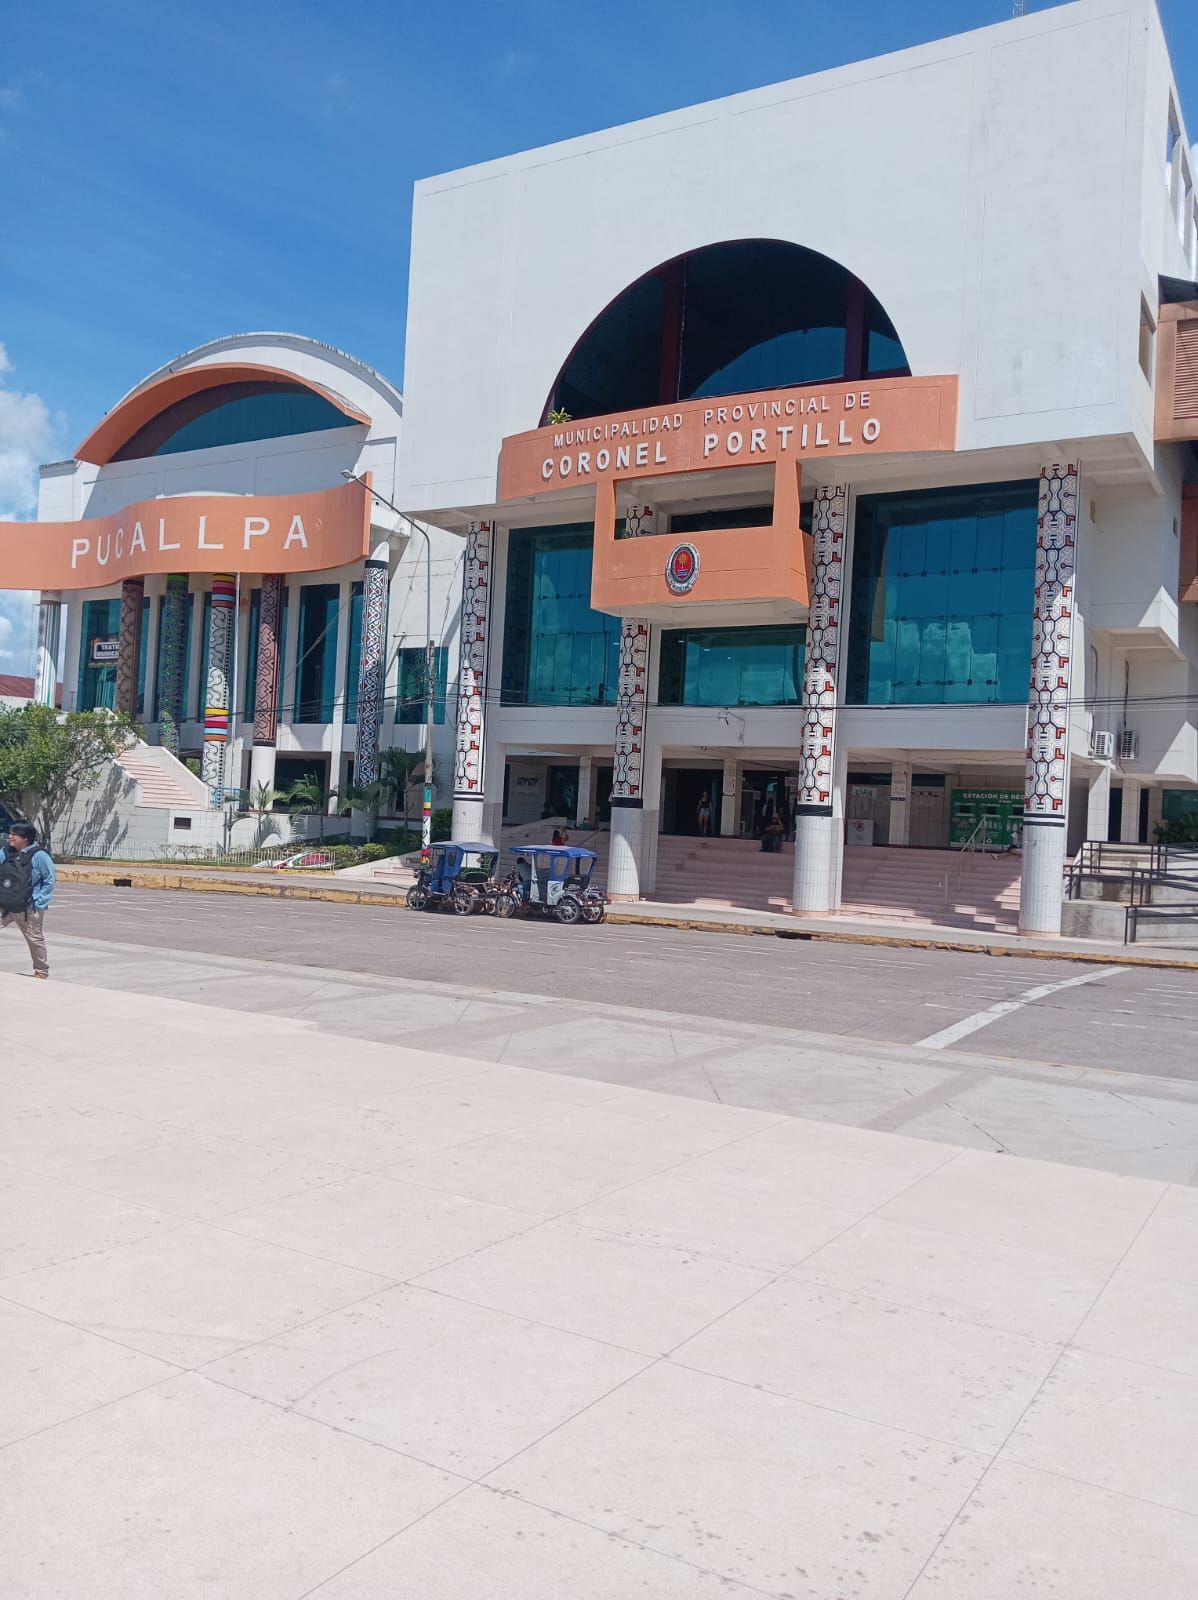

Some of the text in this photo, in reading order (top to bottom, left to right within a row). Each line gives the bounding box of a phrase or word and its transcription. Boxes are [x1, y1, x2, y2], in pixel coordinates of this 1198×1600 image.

[554, 391, 871, 448] MUNICIPALIDAD PROVINCIAL DE
[542, 418, 881, 479] CORONEL PORTILLO
[71, 515, 309, 569] PUCALLPA
